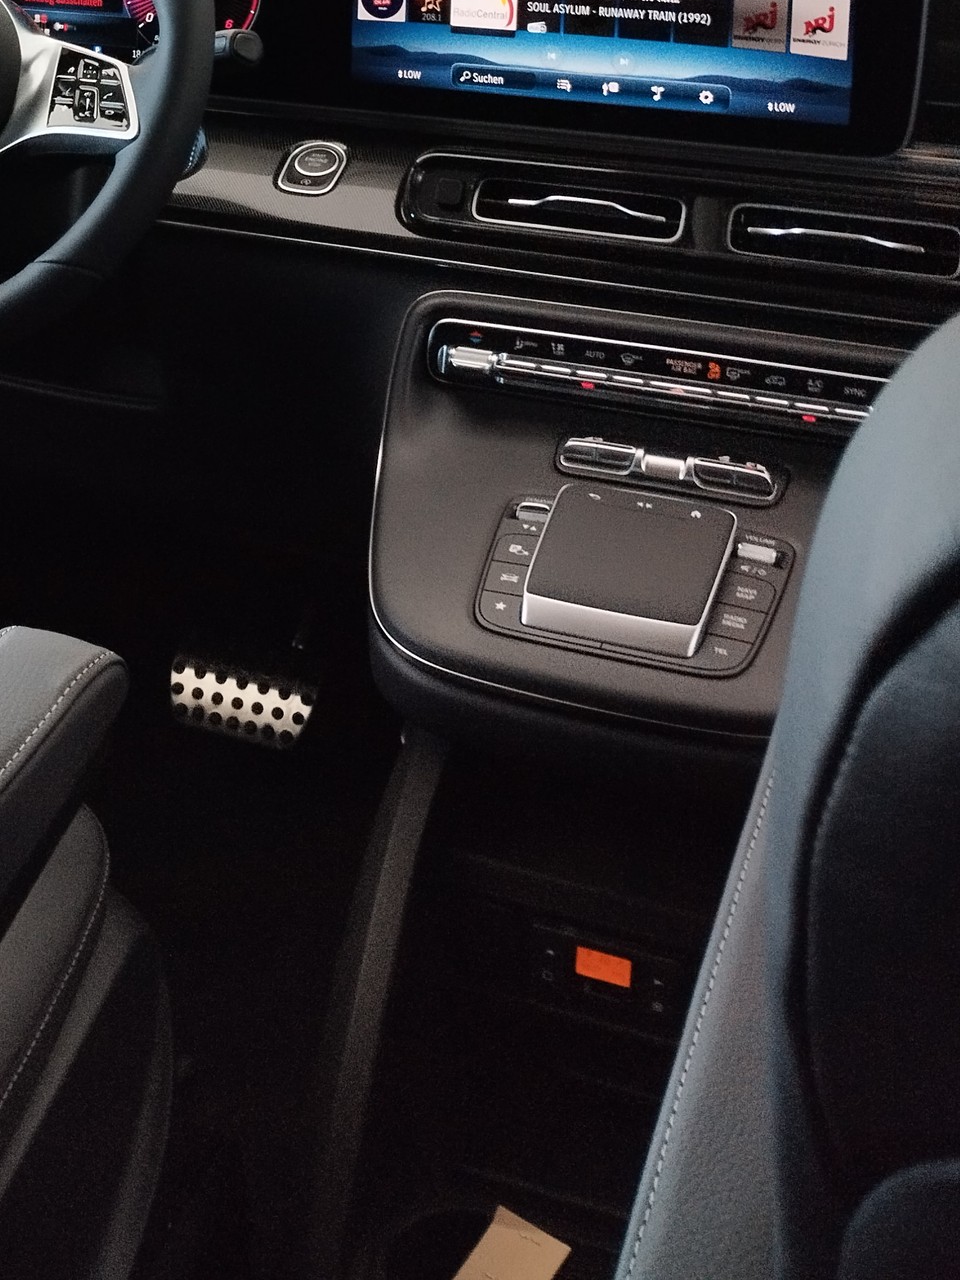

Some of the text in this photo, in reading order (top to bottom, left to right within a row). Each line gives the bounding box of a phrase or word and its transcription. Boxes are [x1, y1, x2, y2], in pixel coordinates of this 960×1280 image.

[145, 12, 154, 23] 0
[527, 1, 551, 14] SOUL
[552, 3, 590, 16] ASYLUM
[598, 6, 646, 20] RUNAWAY
[647, 10, 676, 22] TRAIN
[677, 12, 711, 26] (1992)
[224, 19, 233, 29] 6
[404, 70, 421, 81] LOW
[472, 72, 504, 86] Suchen
[774, 101, 796, 114] LOW
[584, 350, 605, 360] AUTO
